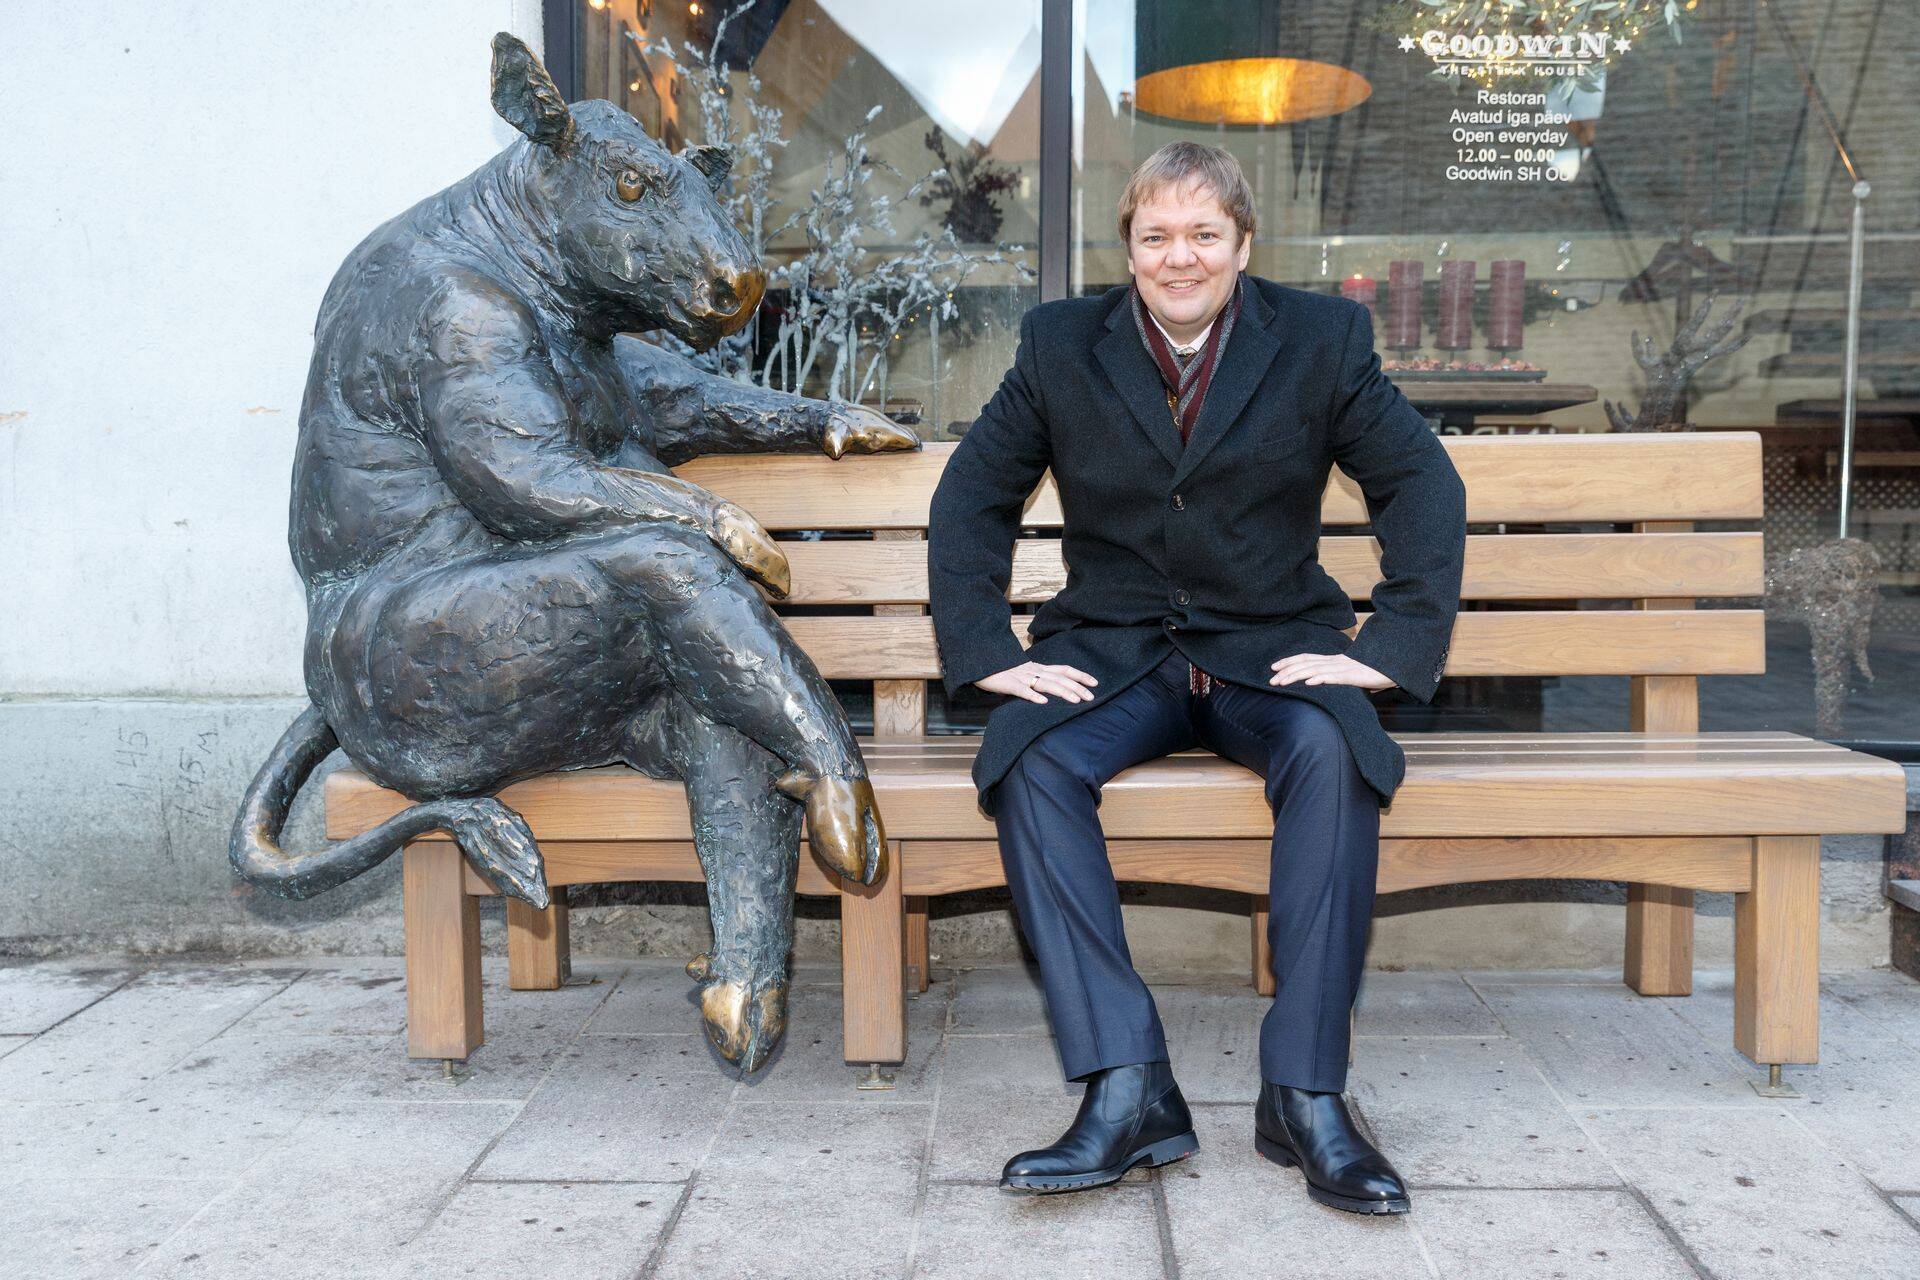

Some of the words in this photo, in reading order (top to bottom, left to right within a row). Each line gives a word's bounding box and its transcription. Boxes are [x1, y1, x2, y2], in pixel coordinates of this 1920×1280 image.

[1422, 30, 1612, 58] GOODWIN
[1440, 65, 1468, 76] THE
[1534, 65, 1586, 76] HOUSE
[1477, 89, 1546, 105] Restoran
[1449, 109, 1503, 124] Avatud
[1507, 109, 1530, 128] iga
[1534, 109, 1573, 127] päev
[1452, 128, 1494, 145] Open
[1498, 128, 1569, 147] everyday
[1456, 148, 1497, 163] 12.00
[1514, 148, 1556, 163] 00.00
[1445, 166, 1513, 181] Goodwin
[1516, 166, 1541, 181] SH
